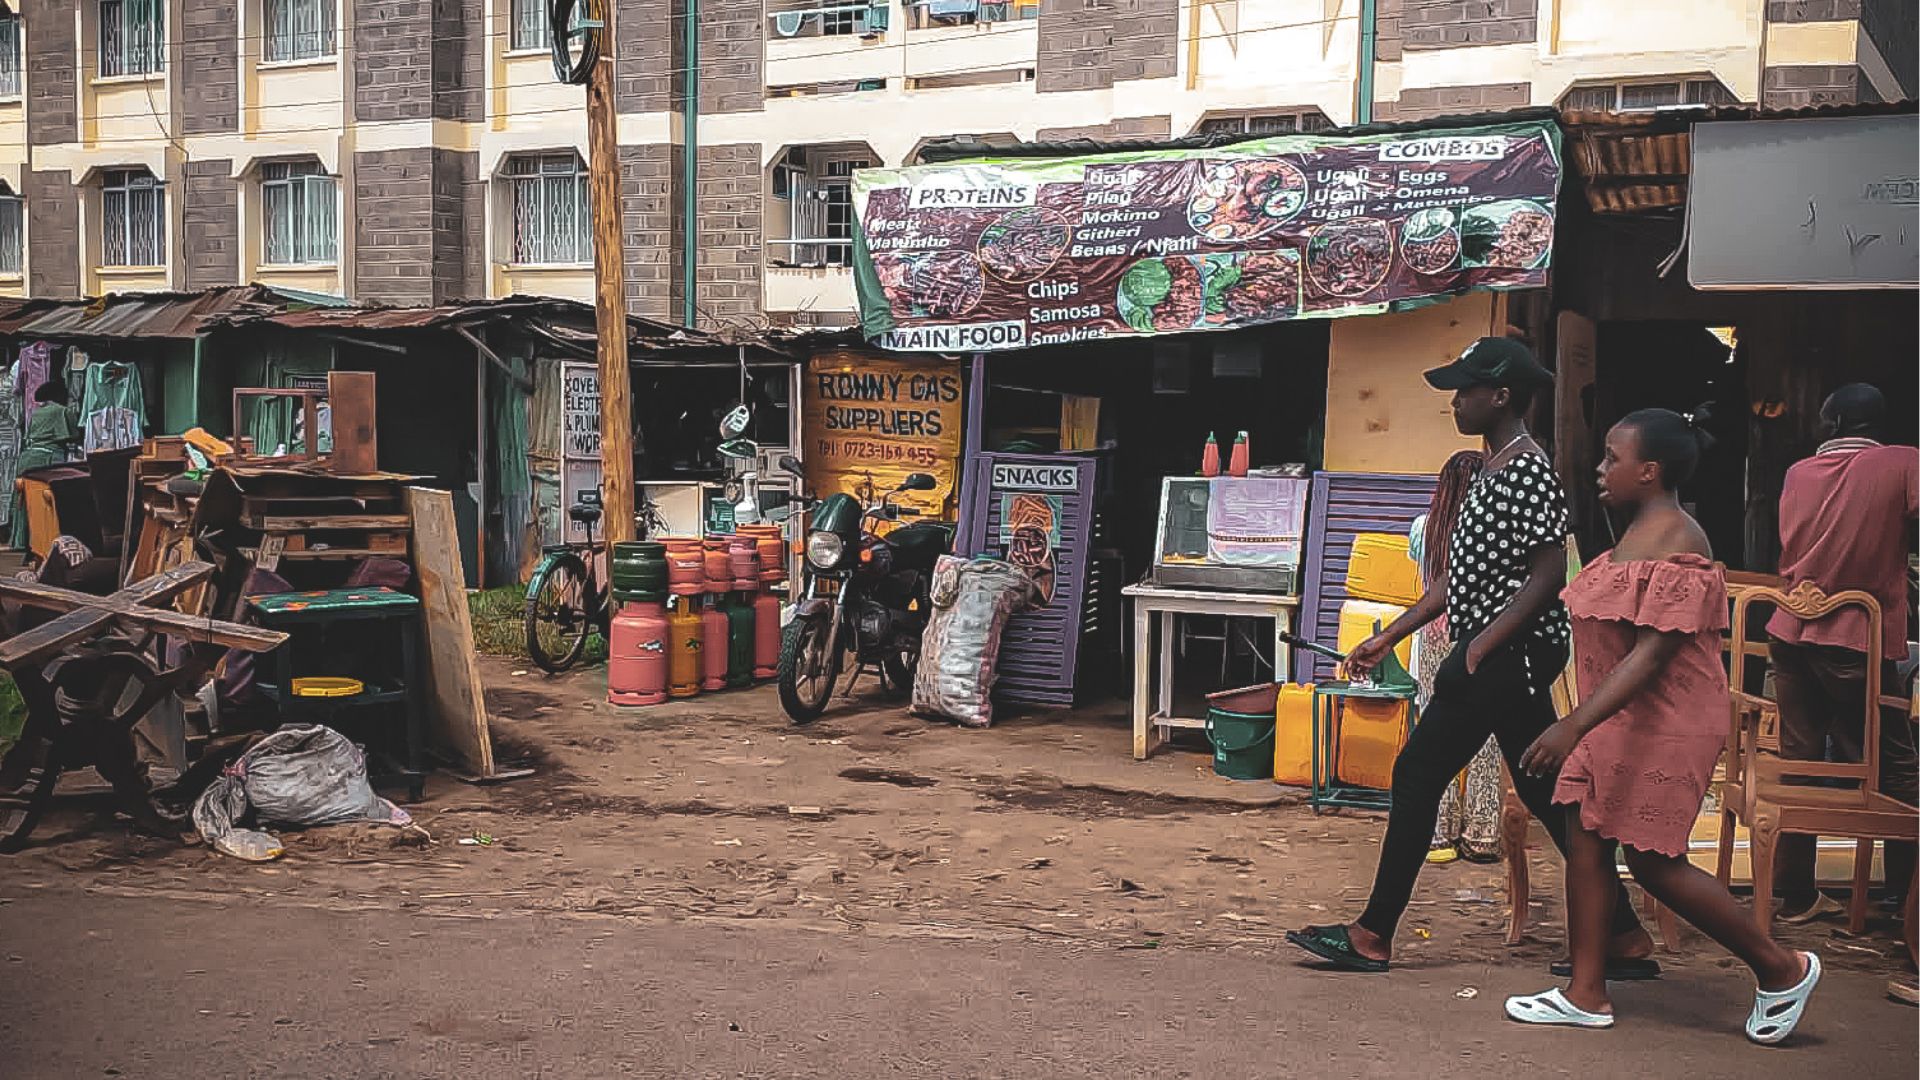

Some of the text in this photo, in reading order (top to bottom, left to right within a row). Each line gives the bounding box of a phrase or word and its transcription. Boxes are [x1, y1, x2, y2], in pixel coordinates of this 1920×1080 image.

[1384, 140, 1500, 158] COMBOS
[1316, 168, 1369, 186] Ugali
[1398, 169, 1448, 186] Eggs
[919, 186, 1027, 205] PROTEINS
[1314, 187, 1367, 206] Ugali
[1395, 185, 1470, 200] Omena
[1082, 208, 1160, 225] Mokimo
[1076, 226, 1142, 241] Githeri
[1071, 243, 1126, 257] Beans
[1028, 280, 1079, 300] Chips
[1030, 303, 1101, 323] Samosa
[886, 325, 1022, 349] MAIN FOOD
[1031, 326, 1107, 347] Smokies
[817, 373, 960, 403] RONNY GAS
[825, 405, 943, 437] SUPPLIERS
[995, 467, 1074, 487] SNACKS
